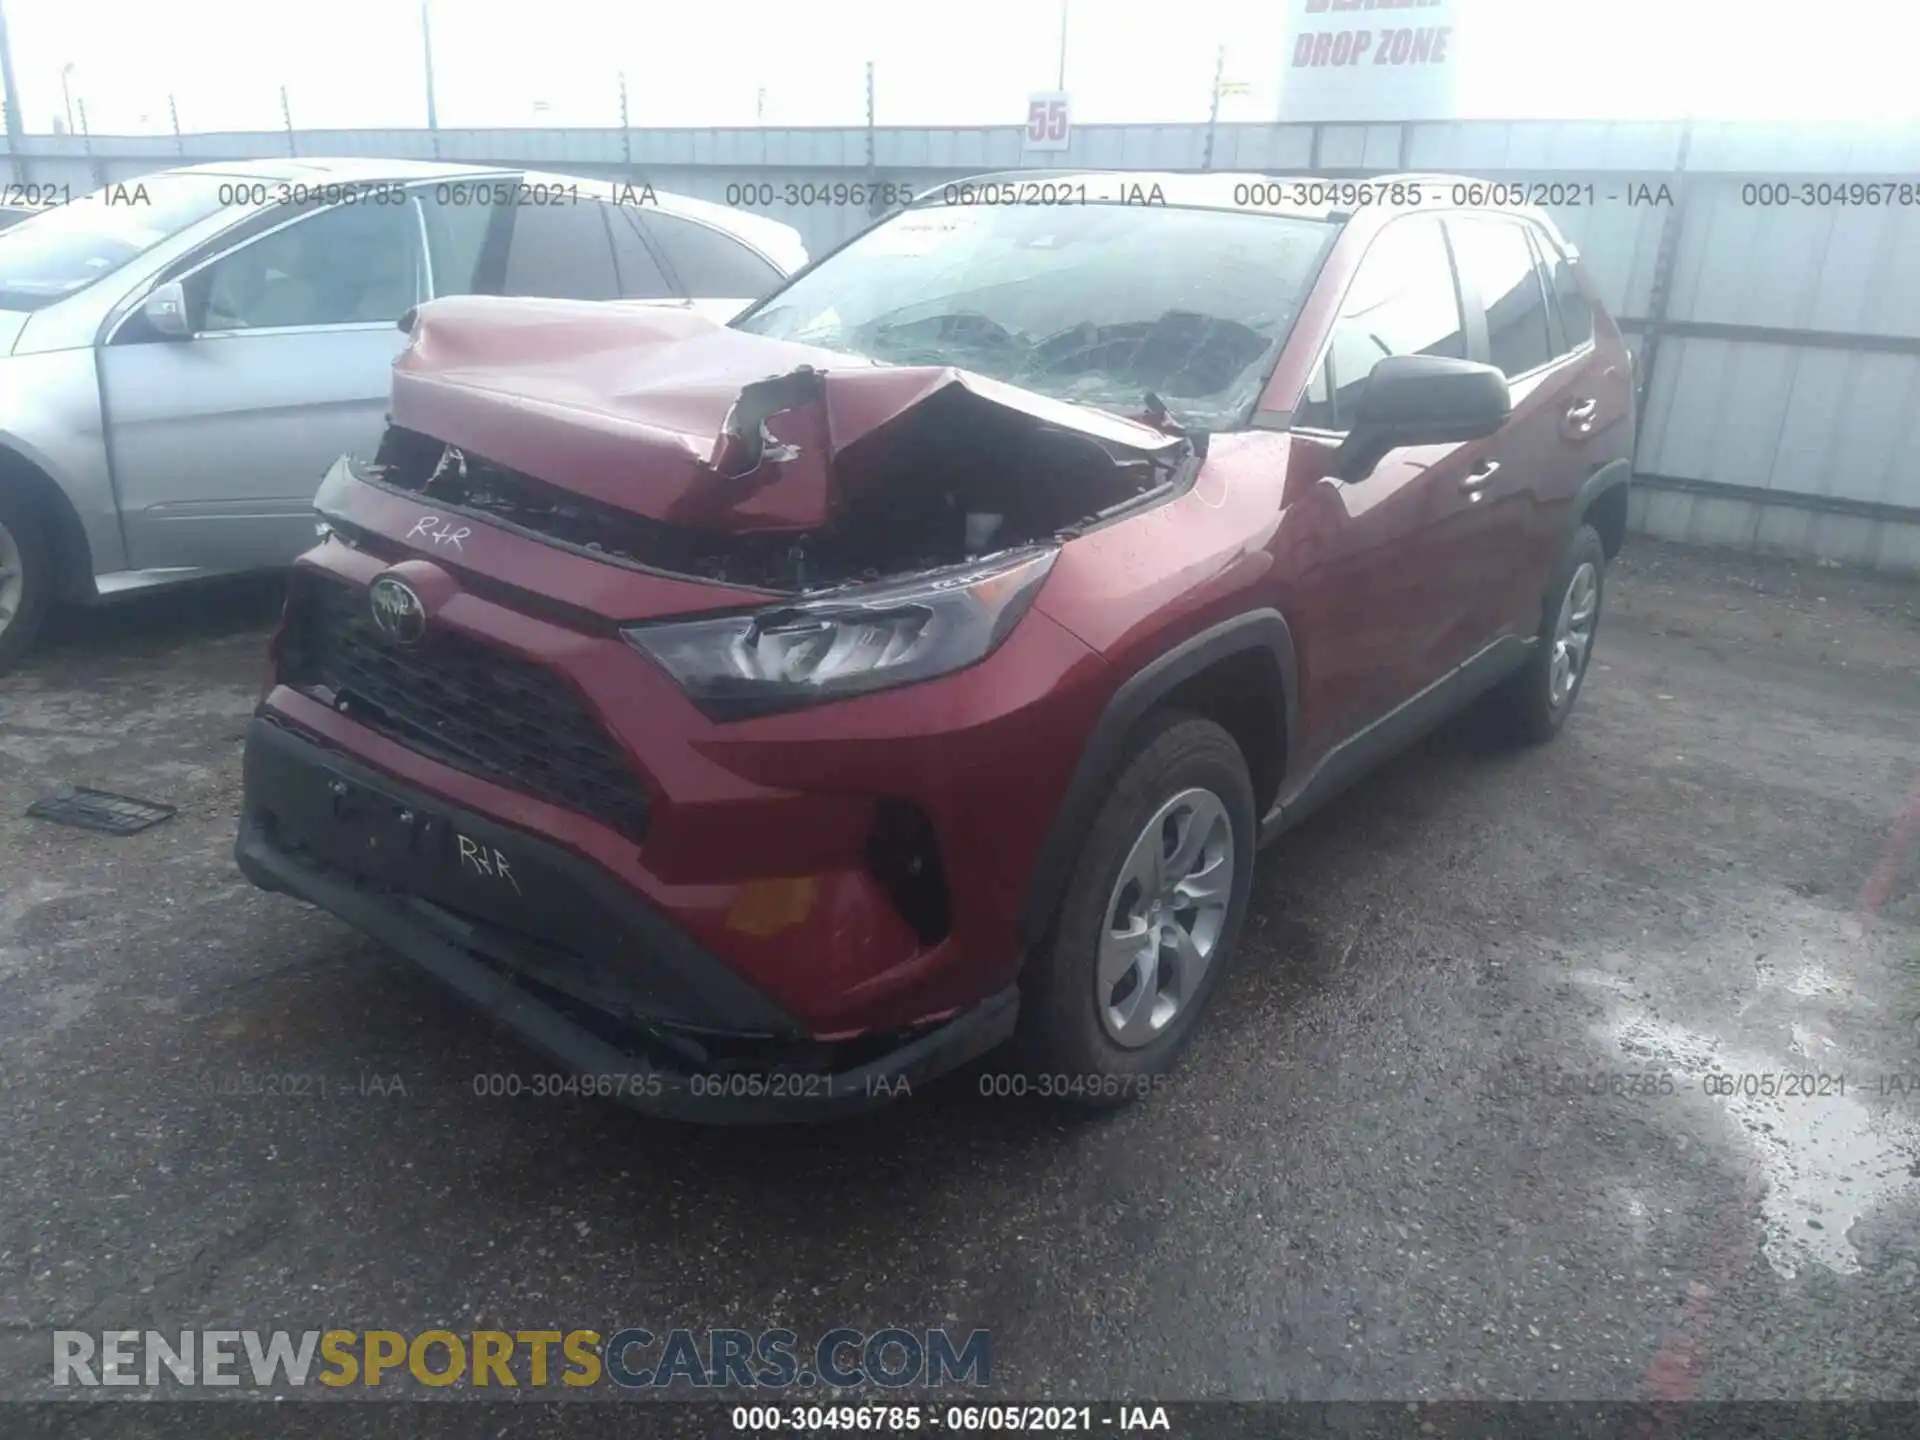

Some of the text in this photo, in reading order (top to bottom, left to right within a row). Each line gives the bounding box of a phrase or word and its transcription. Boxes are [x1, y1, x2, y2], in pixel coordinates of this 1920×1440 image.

[1292, 26, 1452, 67] DROP ZONE
[1028, 101, 1067, 141] 55
